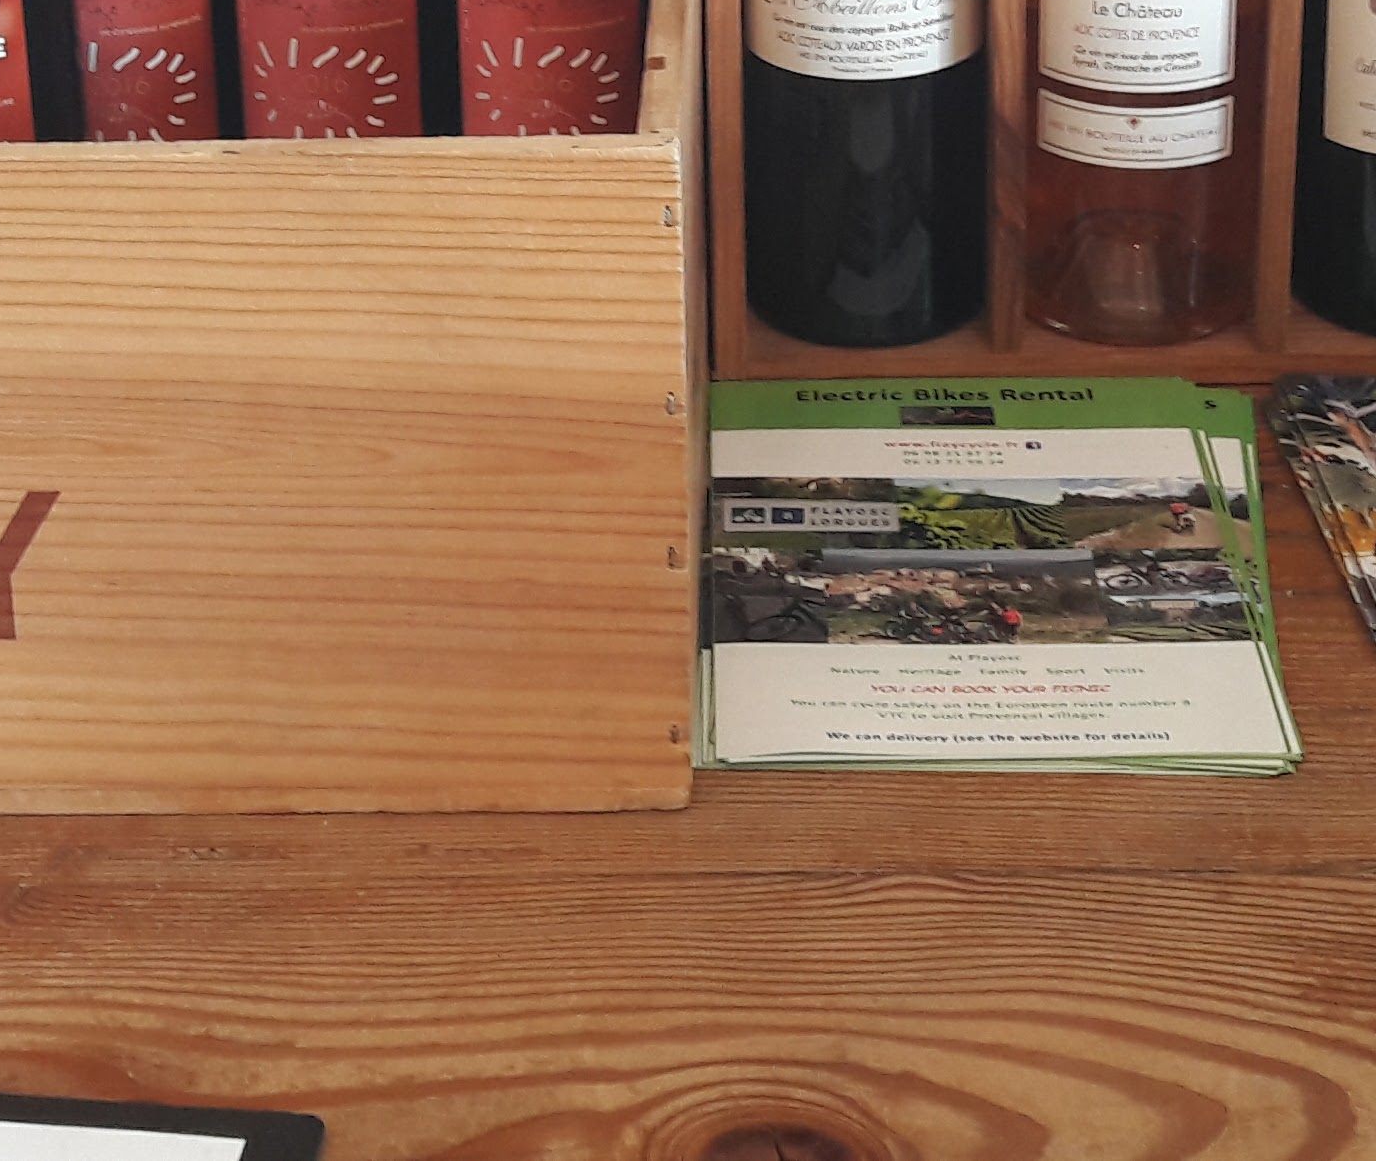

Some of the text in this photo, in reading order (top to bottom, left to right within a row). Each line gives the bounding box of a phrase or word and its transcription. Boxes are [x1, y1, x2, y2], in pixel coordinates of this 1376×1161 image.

[1092, 1, 1109, 16] Le
[796, 387, 1095, 403] Electric Bikes Rental
[826, 732, 851, 741] We
[886, 733, 948, 743] delivery
[988, 733, 1014, 742] the
[1020, 732, 1080, 742] website
[1085, 732, 1106, 742] for
[1111, 731, 1171, 741] details)
